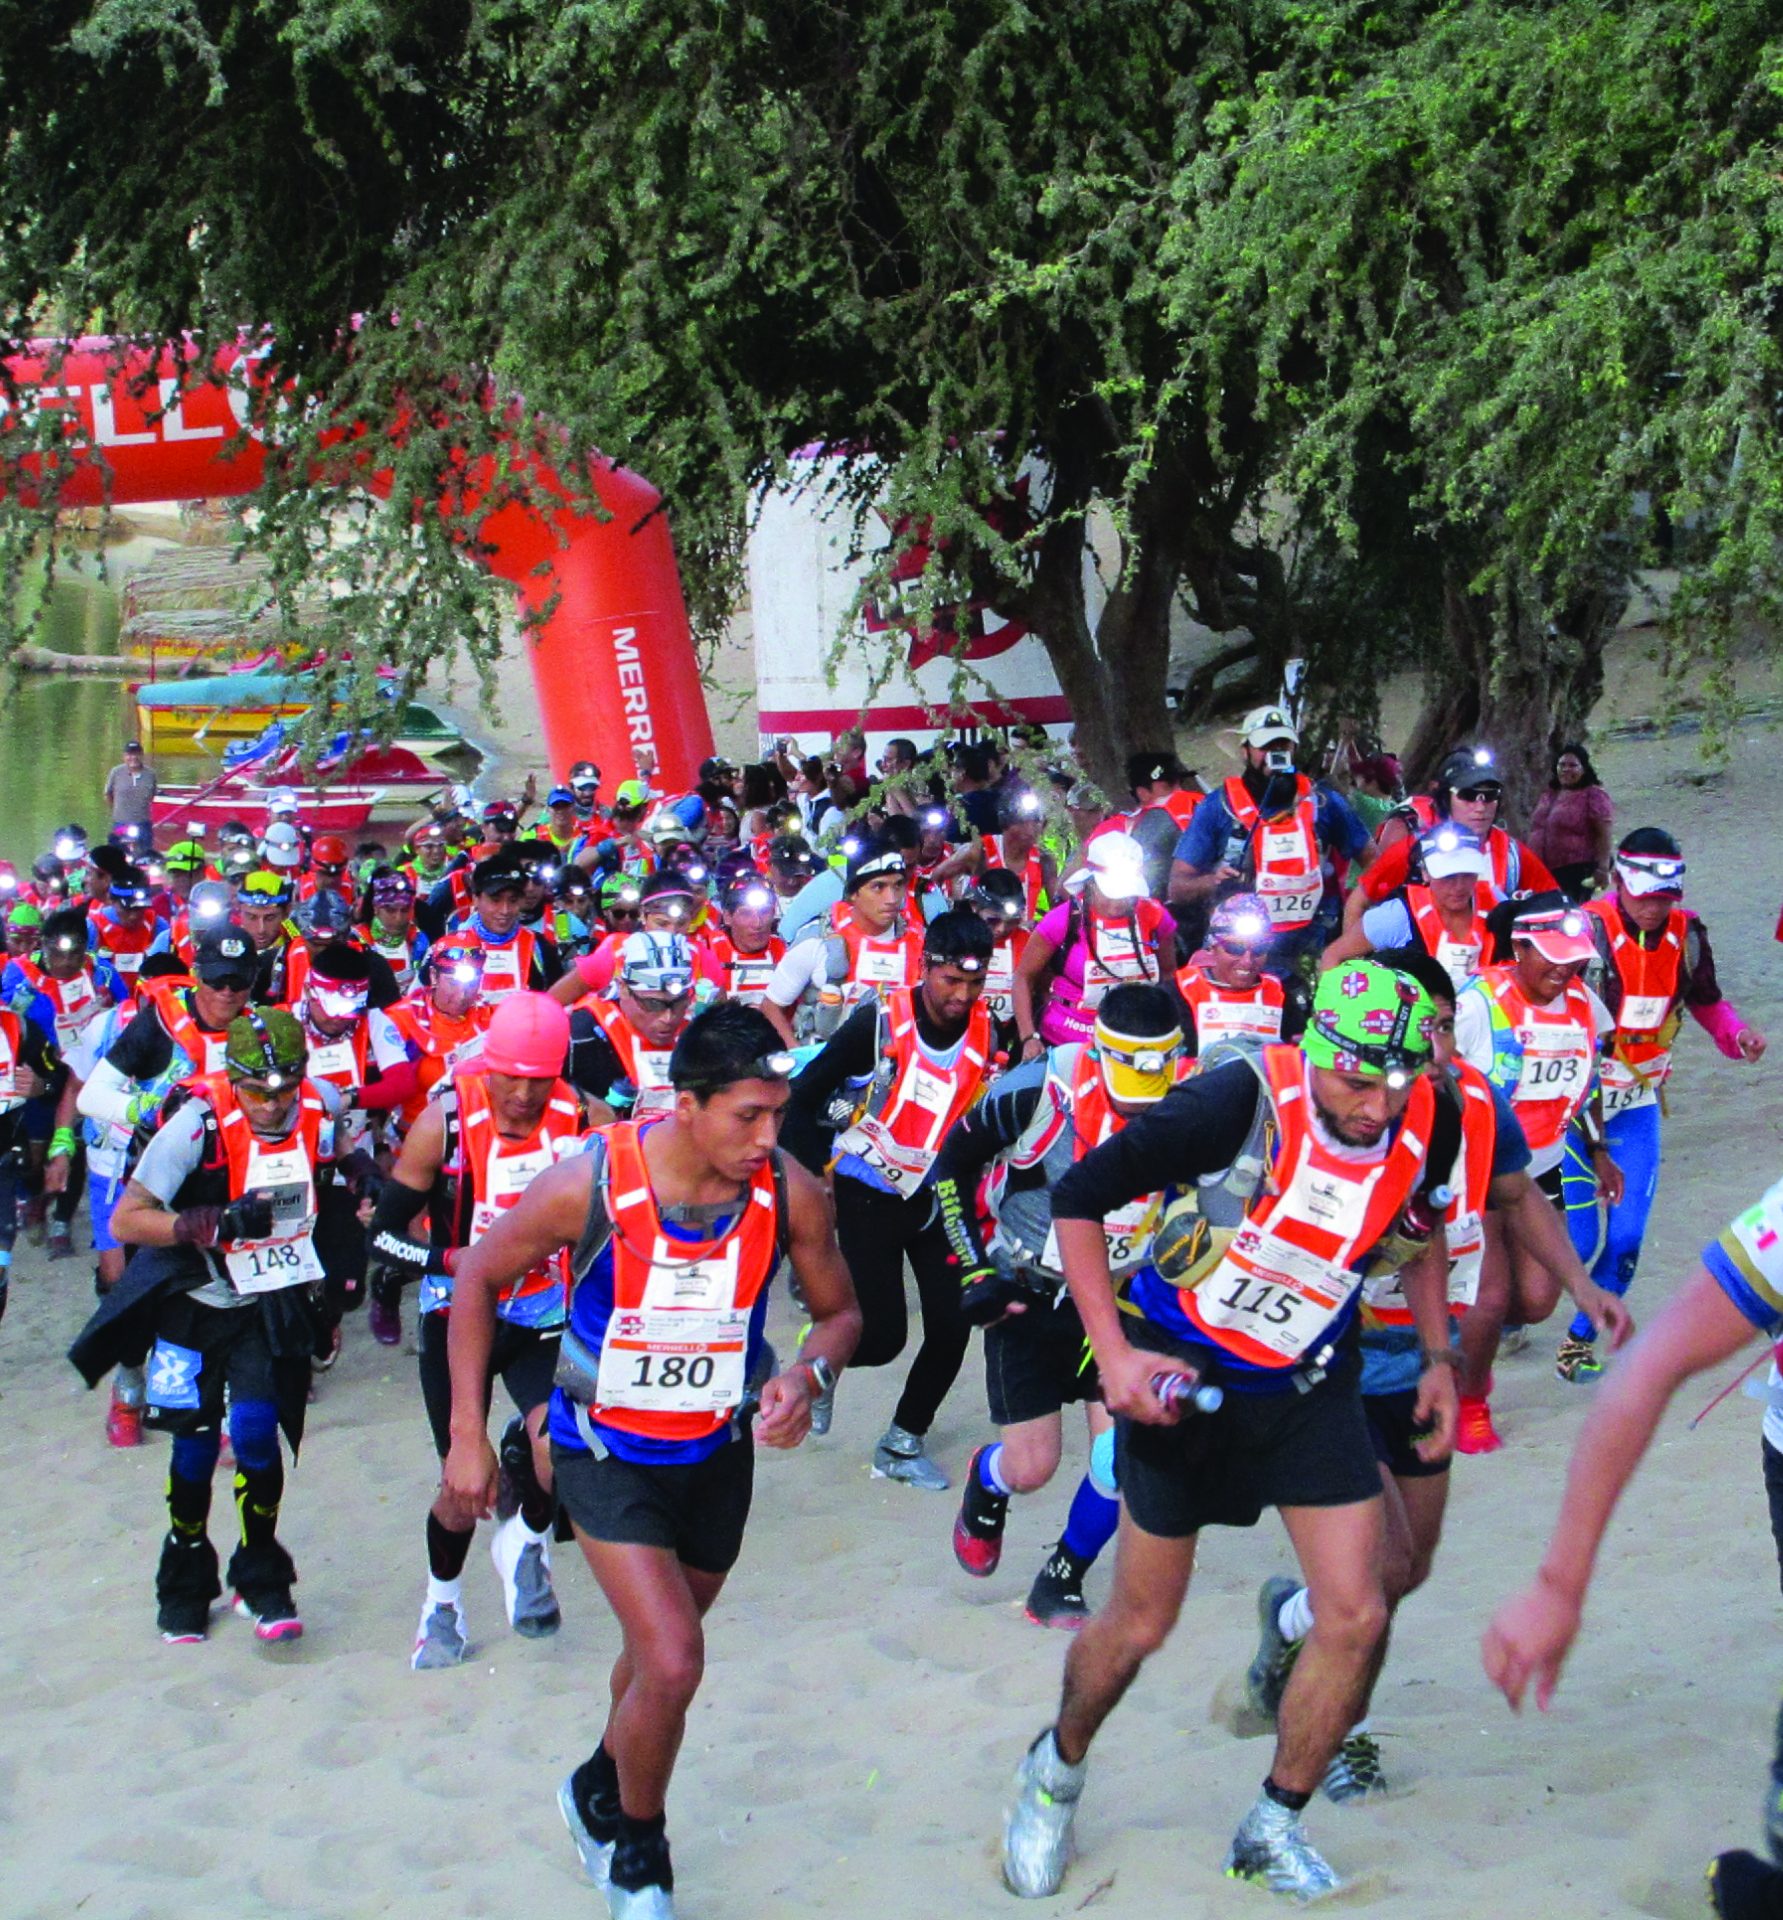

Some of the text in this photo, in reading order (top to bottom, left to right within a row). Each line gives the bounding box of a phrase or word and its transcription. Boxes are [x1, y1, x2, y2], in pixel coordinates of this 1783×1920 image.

[1272, 894, 1313, 913] 126
[1529, 1058, 1579, 1085] 103
[248, 1244, 301, 1277] 148
[373, 1229, 431, 1267] saucony
[1218, 1277, 1303, 1325] 115
[630, 1354, 715, 1389] 180
